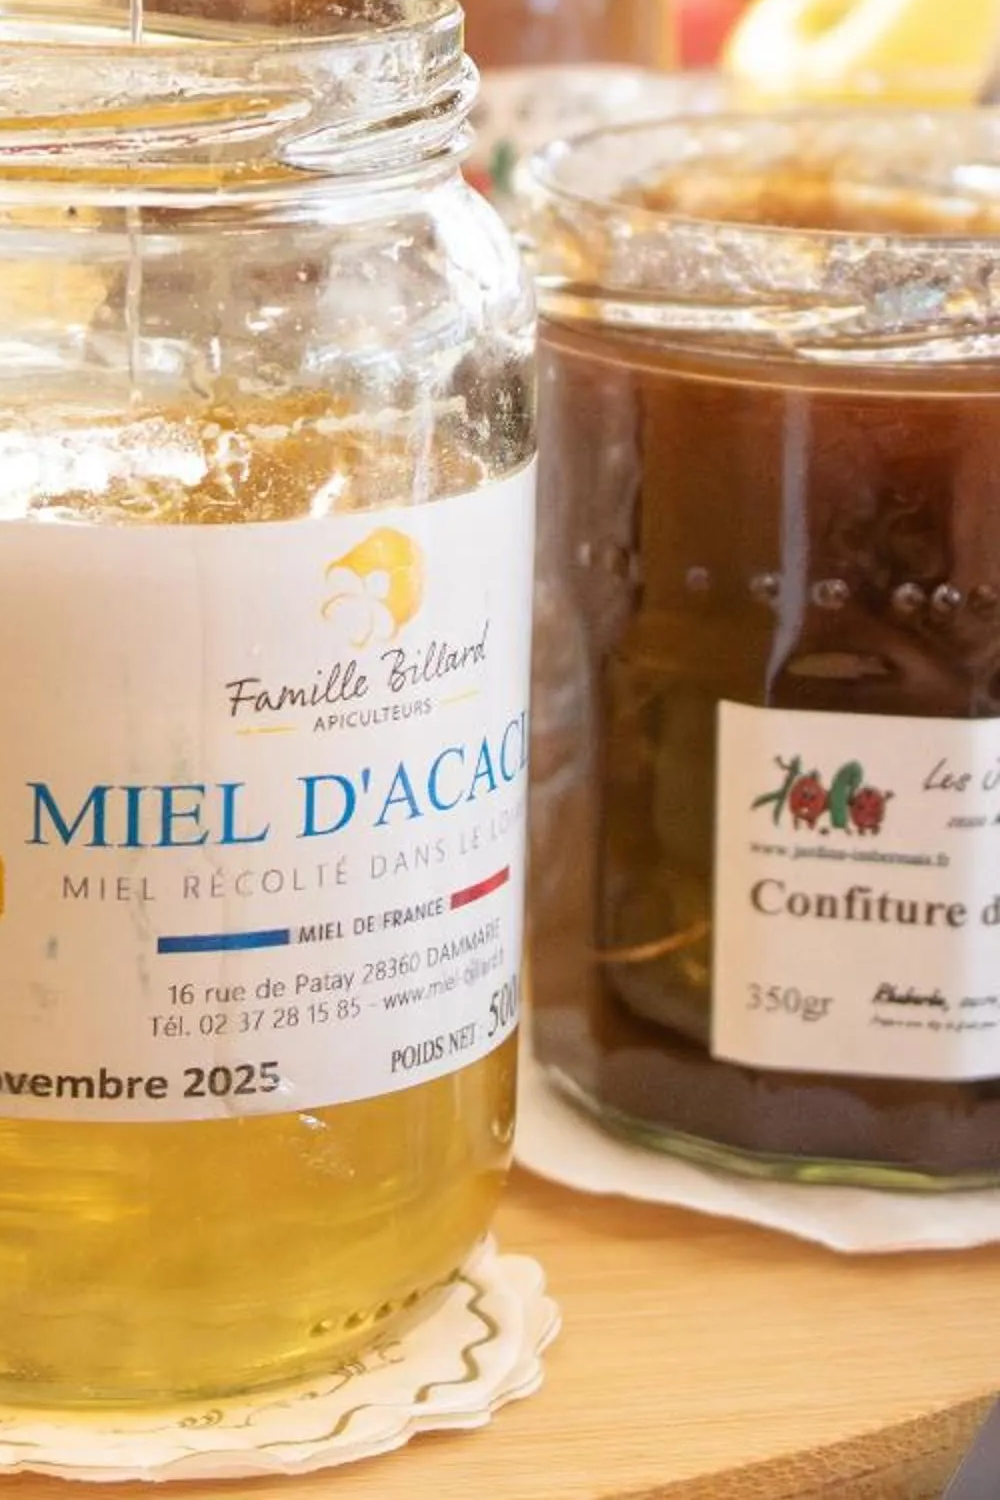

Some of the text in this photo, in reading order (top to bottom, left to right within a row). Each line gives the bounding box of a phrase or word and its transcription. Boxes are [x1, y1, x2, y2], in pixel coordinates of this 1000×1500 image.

[225, 618, 490, 717] Famille Billard
[313, 698, 434, 732] APICULTEURS
[24, 780, 271, 849] MIEL
[62, 874, 155, 901] MIEL
[182, 854, 349, 900] RÉCOLTÉ
[370, 838, 447, 880] DANS
[459, 826, 482, 855] LE
[297, 897, 444, 944] MIEL DE FRANCE
[750, 877, 968, 928] Confiture
[168, 983, 194, 1005] 16
[204, 985, 246, 1004] rue
[255, 977, 286, 999] de
[295, 971, 355, 995] Patay
[361, 951, 421, 985] 28360
[747, 982, 834, 1022] 350gr
[151, 1014, 191, 1038] Tél.
[200, 1013, 228, 1035] 02
[238, 1010, 265, 1033] 37
[273, 1007, 299, 1029] 28
[308, 1003, 329, 1025] 15
[337, 996, 361, 1020] 85
[391, 1036, 444, 1074] POIDS
[449, 1022, 476, 1054] NET
[183, 1060, 281, 1098] 2025
